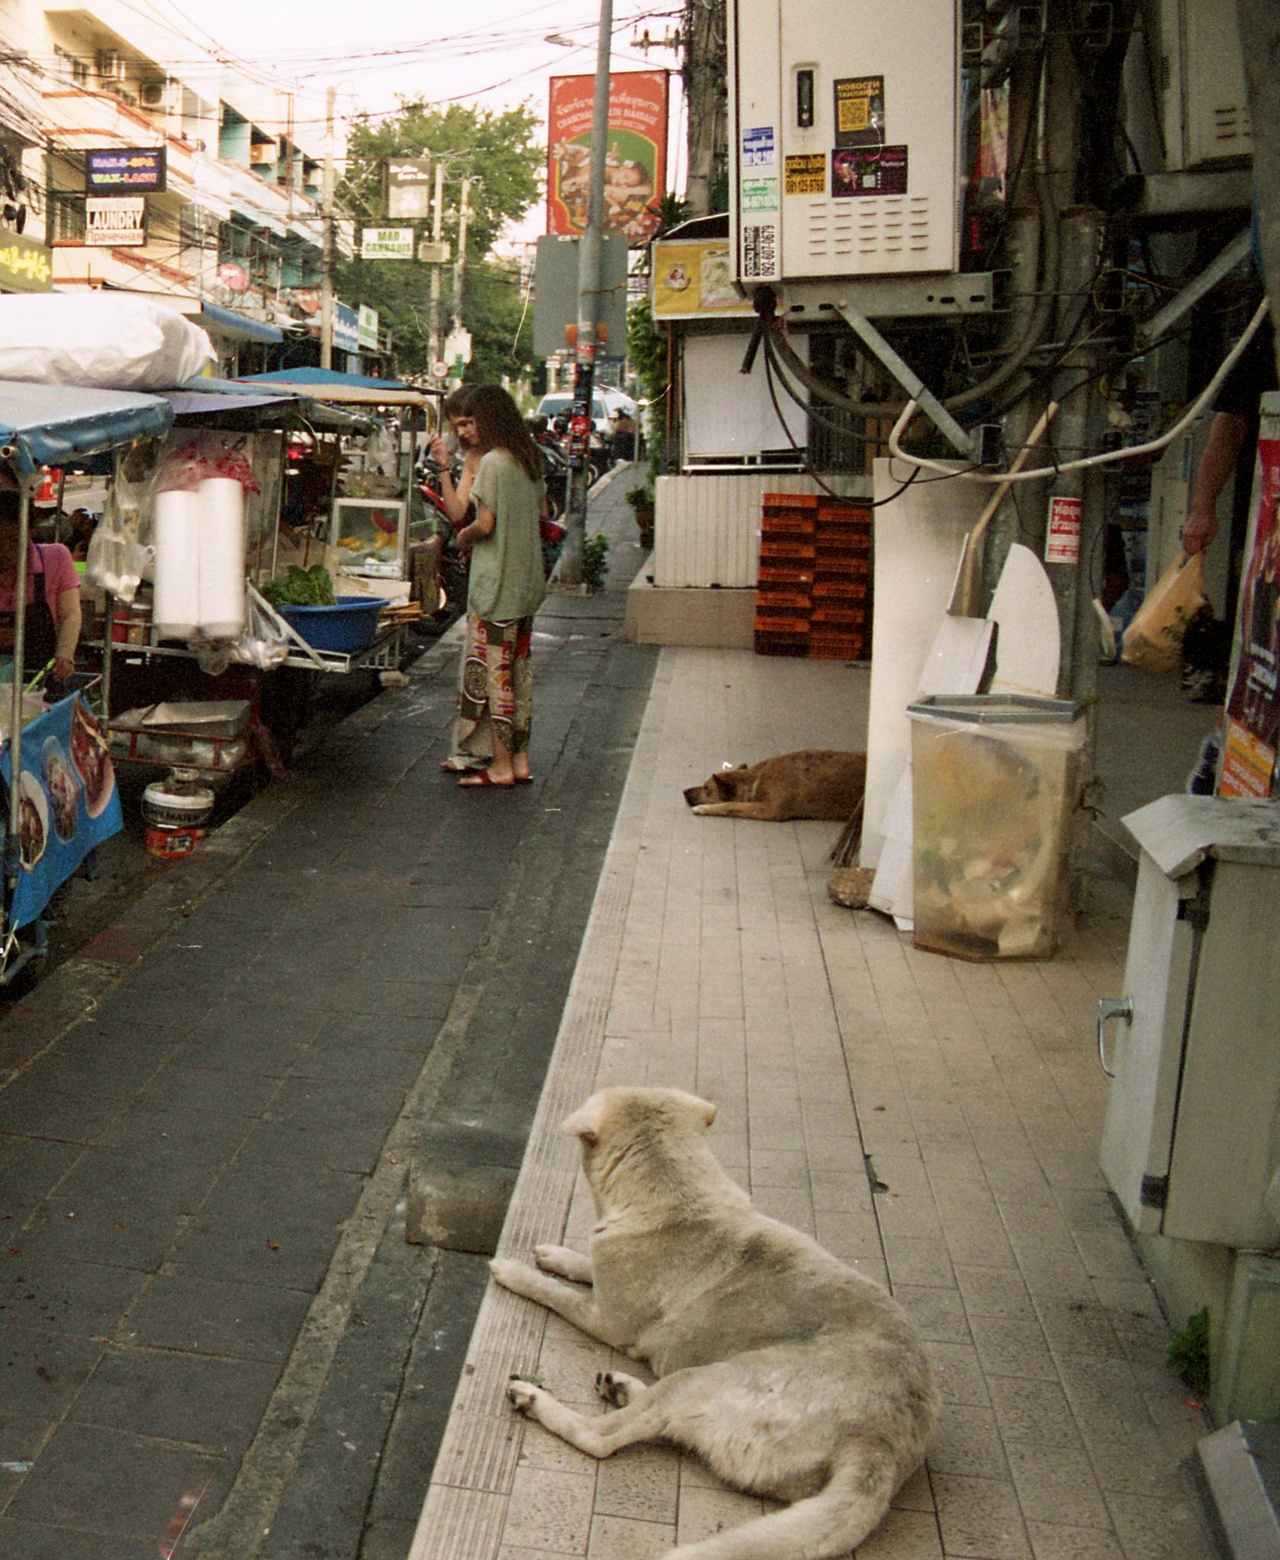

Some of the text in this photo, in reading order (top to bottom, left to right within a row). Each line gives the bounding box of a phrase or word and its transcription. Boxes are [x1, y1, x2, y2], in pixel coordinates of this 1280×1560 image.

[837, 80, 880, 91] НОВОСТИ
[86, 211, 142, 230] LAUNDRY
[86, 231, 143, 243] Прачечная
[761, 225, 776, 277] 092-607-0679
